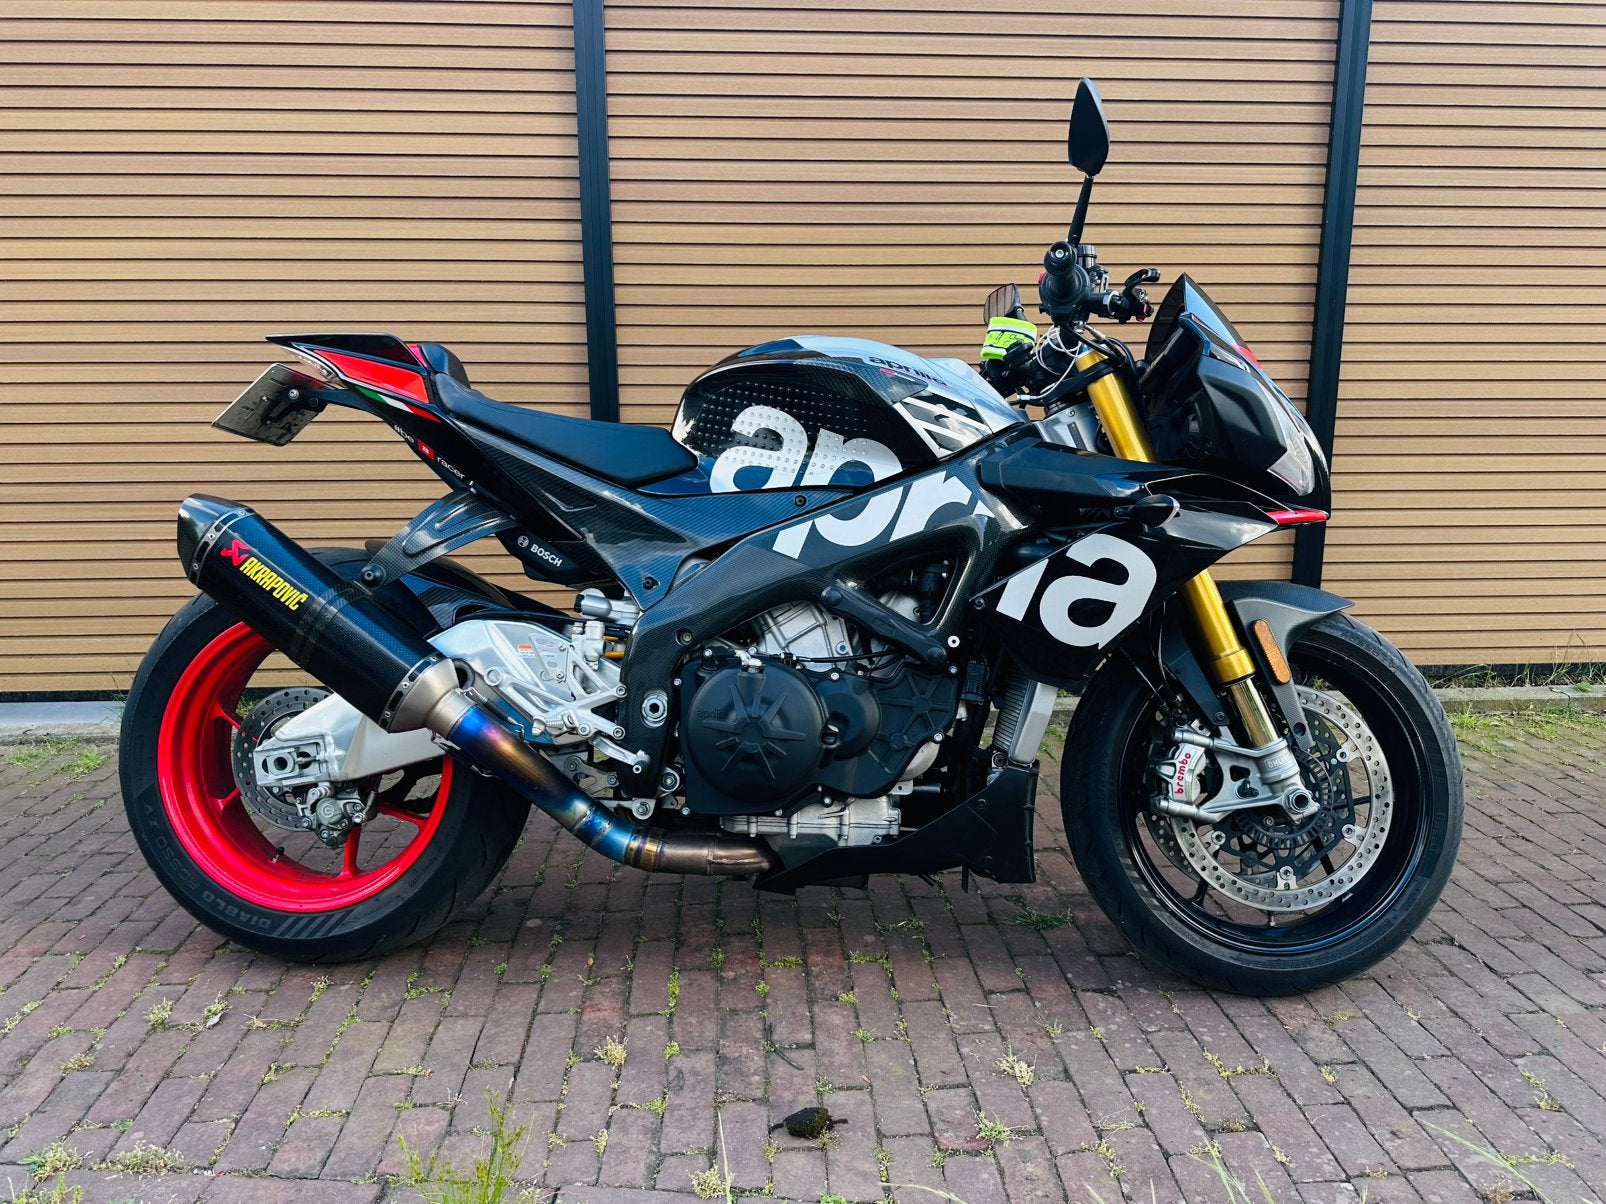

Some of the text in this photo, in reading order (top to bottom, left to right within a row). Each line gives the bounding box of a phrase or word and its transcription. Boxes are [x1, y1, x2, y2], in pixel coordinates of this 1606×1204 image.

[436, 456, 465, 479] racer
[530, 543, 563, 567] BOSCH
[1174, 752, 1191, 795] brembo
[155, 835, 200, 890] ROSSO
[201, 890, 272, 929] DIABLO
